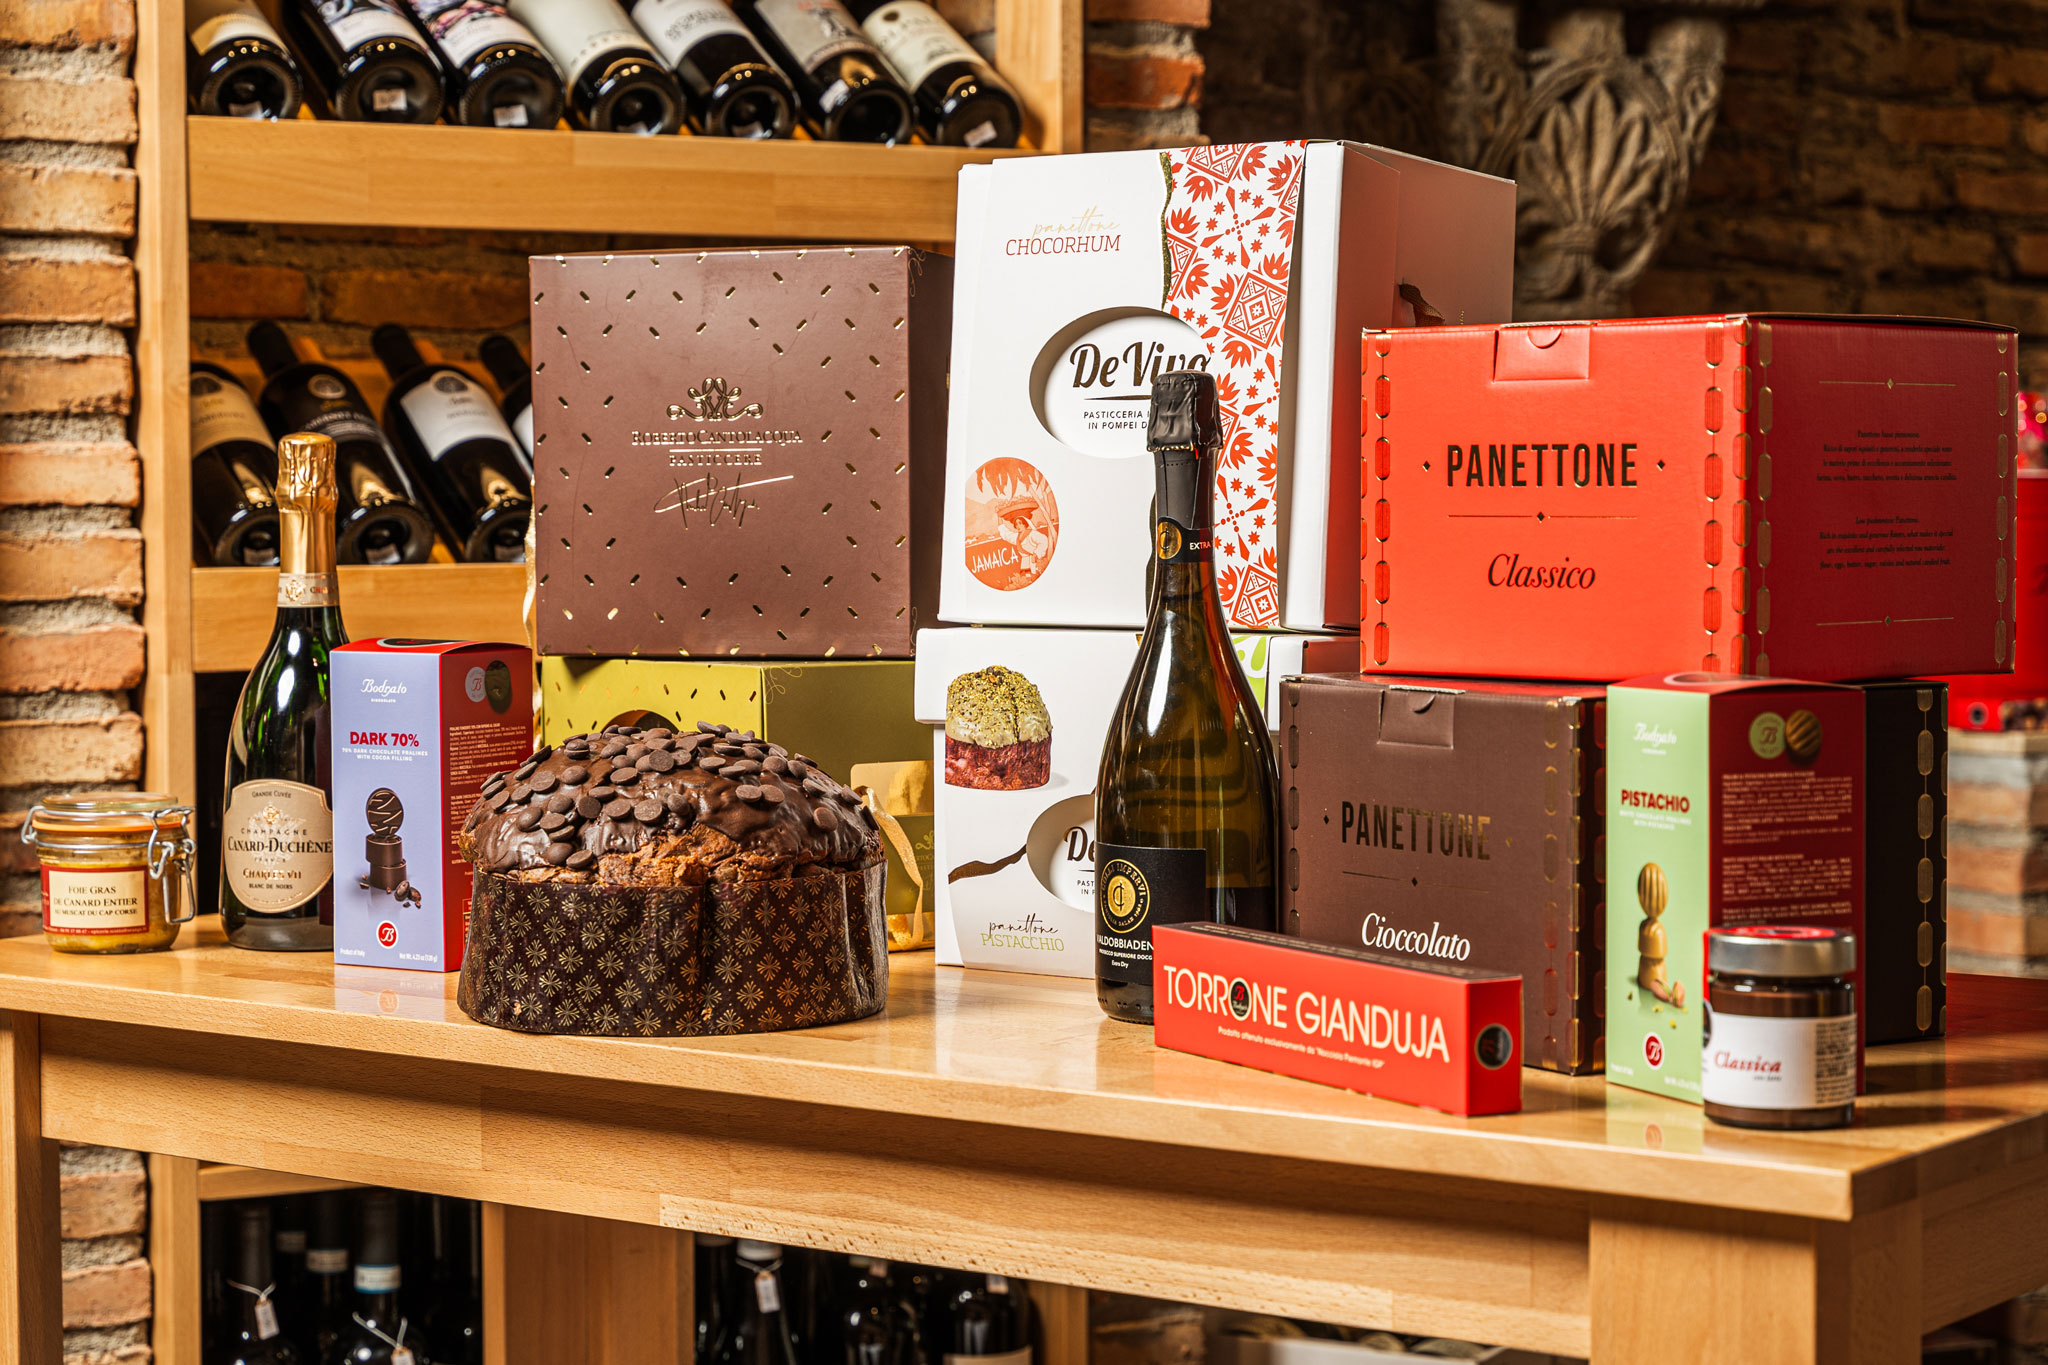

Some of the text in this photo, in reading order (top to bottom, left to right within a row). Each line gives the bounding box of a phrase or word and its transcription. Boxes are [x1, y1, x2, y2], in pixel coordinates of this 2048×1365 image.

[1031, 205, 1121, 241] panettone
[1005, 234, 1122, 257] CHOCORHUM
[1069, 343, 1120, 389] De
[1083, 410, 1143, 419] PASTICCERIA
[1088, 422, 1098, 430] IN
[1102, 421, 1138, 430] POMPEI
[669, 454, 762, 467] PASTICCERE
[1446, 443, 1638, 488] PANETTONE
[1190, 541, 1211, 551] EXTRA
[971, 547, 1019, 574] JAMAICA
[1487, 553, 1596, 589] Classico
[360, 678, 407, 697] Bodrato
[350, 731, 420, 747] DARK 70%
[1620, 788, 1690, 814] PISTACHIO
[240, 827, 308, 836] CHAMPAGNE
[1341, 800, 1491, 861] PANETTONE
[63, 897, 101, 906] CANARD
[103, 897, 138, 906] ENTIER
[68, 885, 116, 895] FOIE GRAS
[988, 913, 1058, 936] panettone
[980, 932, 1065, 952] PISTACCHIO
[1361, 912, 1471, 961] Cioccolato
[1163, 965, 1451, 1064] TORRONE GIANDUJA
[1714, 1050, 1782, 1074] Classica
